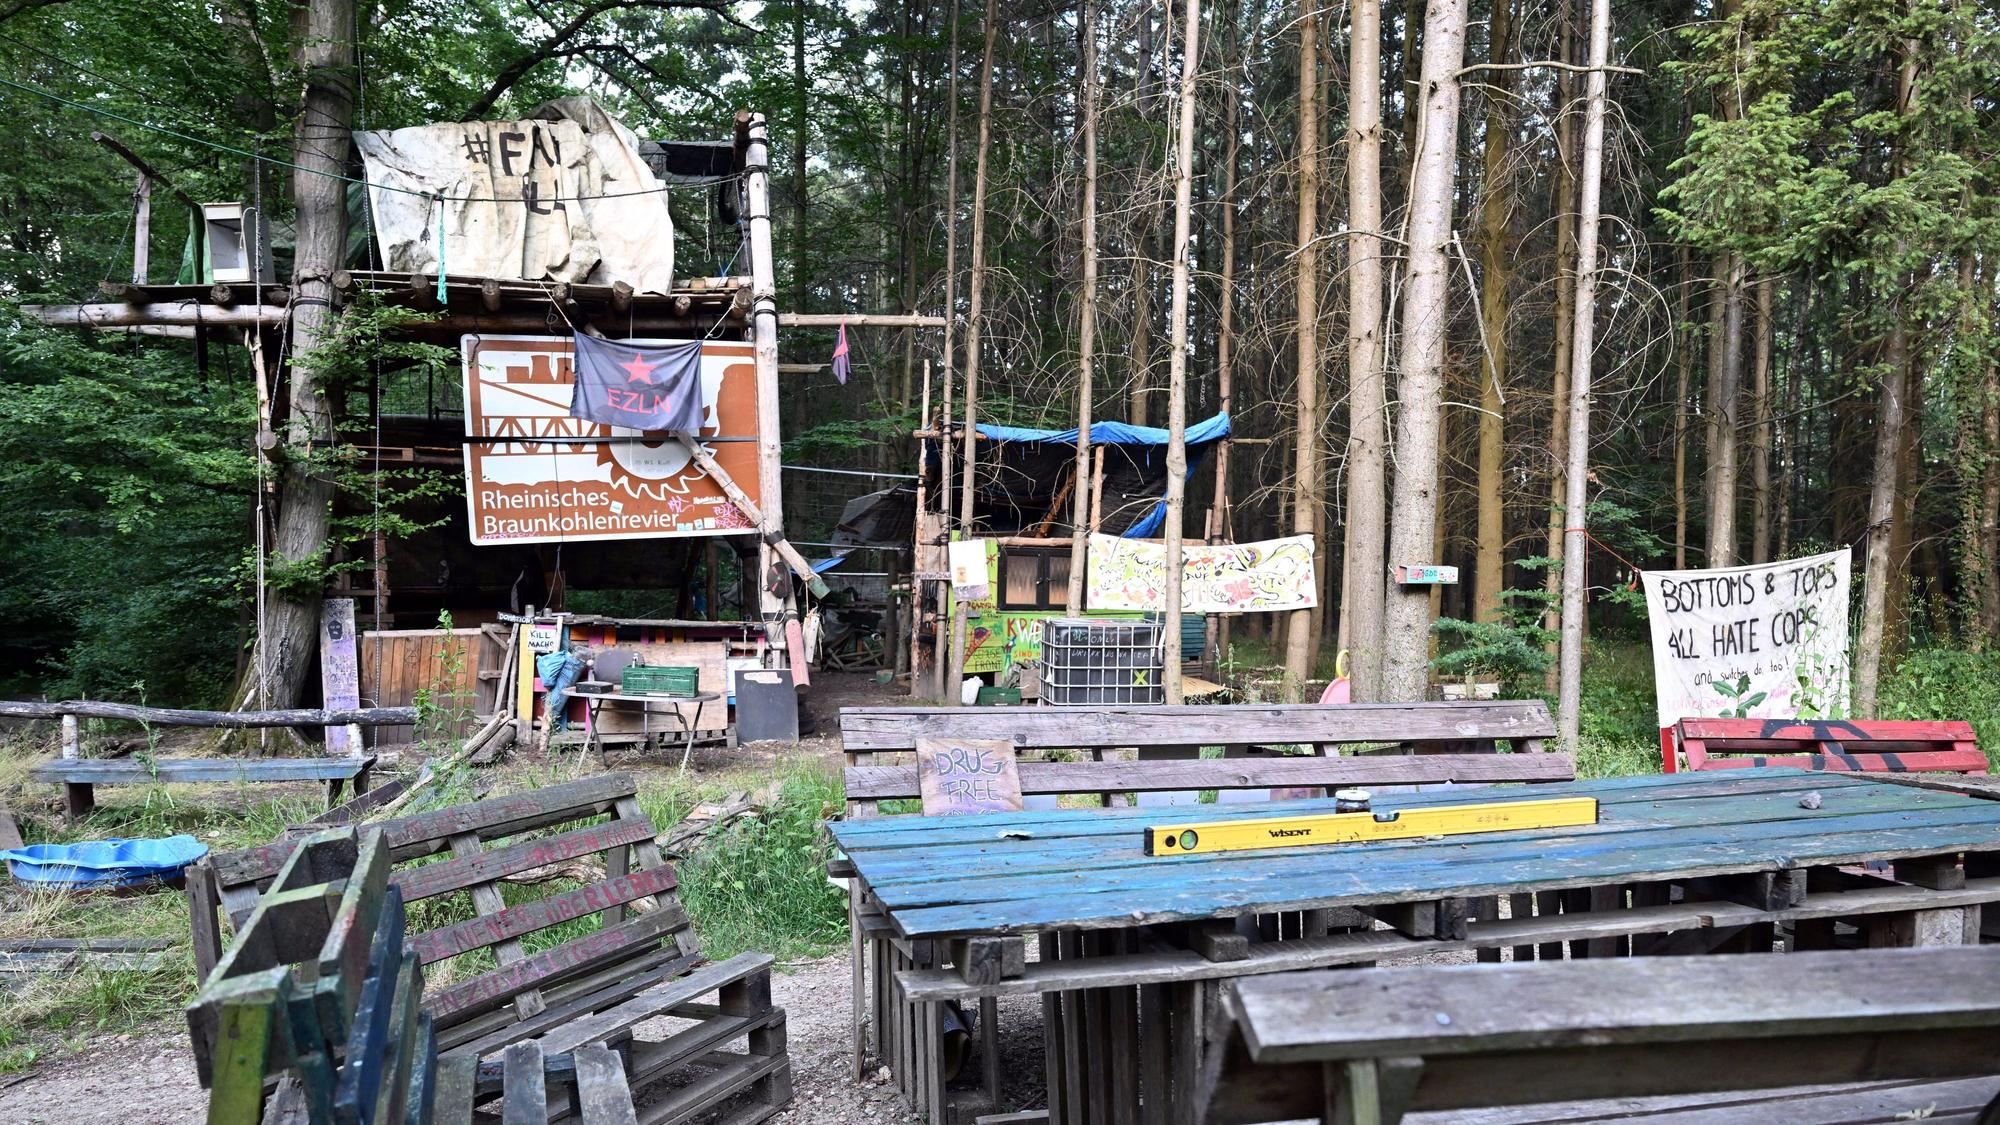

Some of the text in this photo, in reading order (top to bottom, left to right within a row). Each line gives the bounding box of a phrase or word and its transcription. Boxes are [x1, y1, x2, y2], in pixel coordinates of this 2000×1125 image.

[607, 387, 672, 415] EZLN
[481, 487, 609, 510] Rheinisches
[483, 509, 680, 534] Braunkohlenrevier
[1660, 561, 1838, 613] BOTTOMS & TOPS
[499, 613, 534, 624] DONATIONS
[530, 630, 551, 639] KILL
[1668, 605, 1818, 659] ALL HATE COPS
[1694, 669, 1713, 686] and
[935, 748, 1005, 776] DRUG
[941, 779, 1001, 804] FREE
[1268, 828, 1312, 838] WISENT
